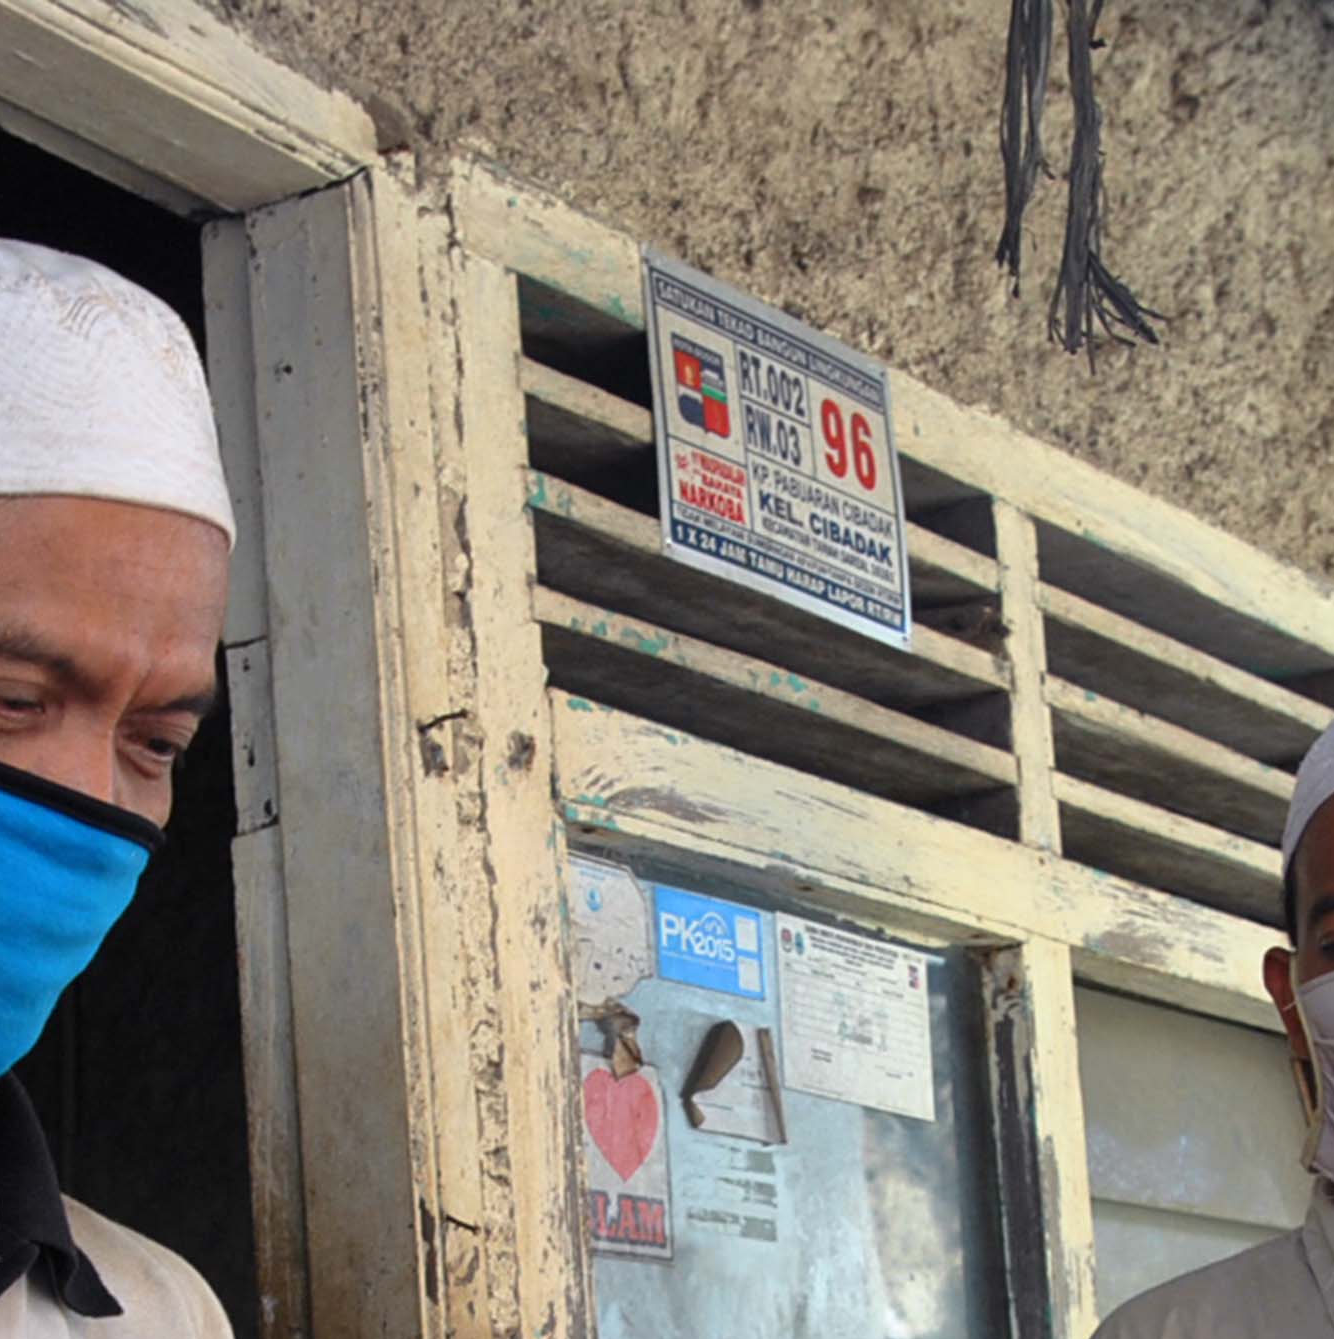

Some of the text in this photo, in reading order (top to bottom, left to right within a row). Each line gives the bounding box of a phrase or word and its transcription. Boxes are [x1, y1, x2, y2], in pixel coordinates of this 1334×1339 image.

[739, 350, 806, 417] RT.002
[745, 404, 801, 467] RW.03
[821, 398, 876, 491] 96
[679, 479, 746, 525] NARKOBA
[758, 490, 893, 567] KEL. CIBADAK
[774, 470, 840, 517] PABUARAN
[842, 501, 893, 540] CIBADAK
[677, 524, 684, 541] 1
[687, 527, 698, 546] X
[700, 532, 717, 553] 24
